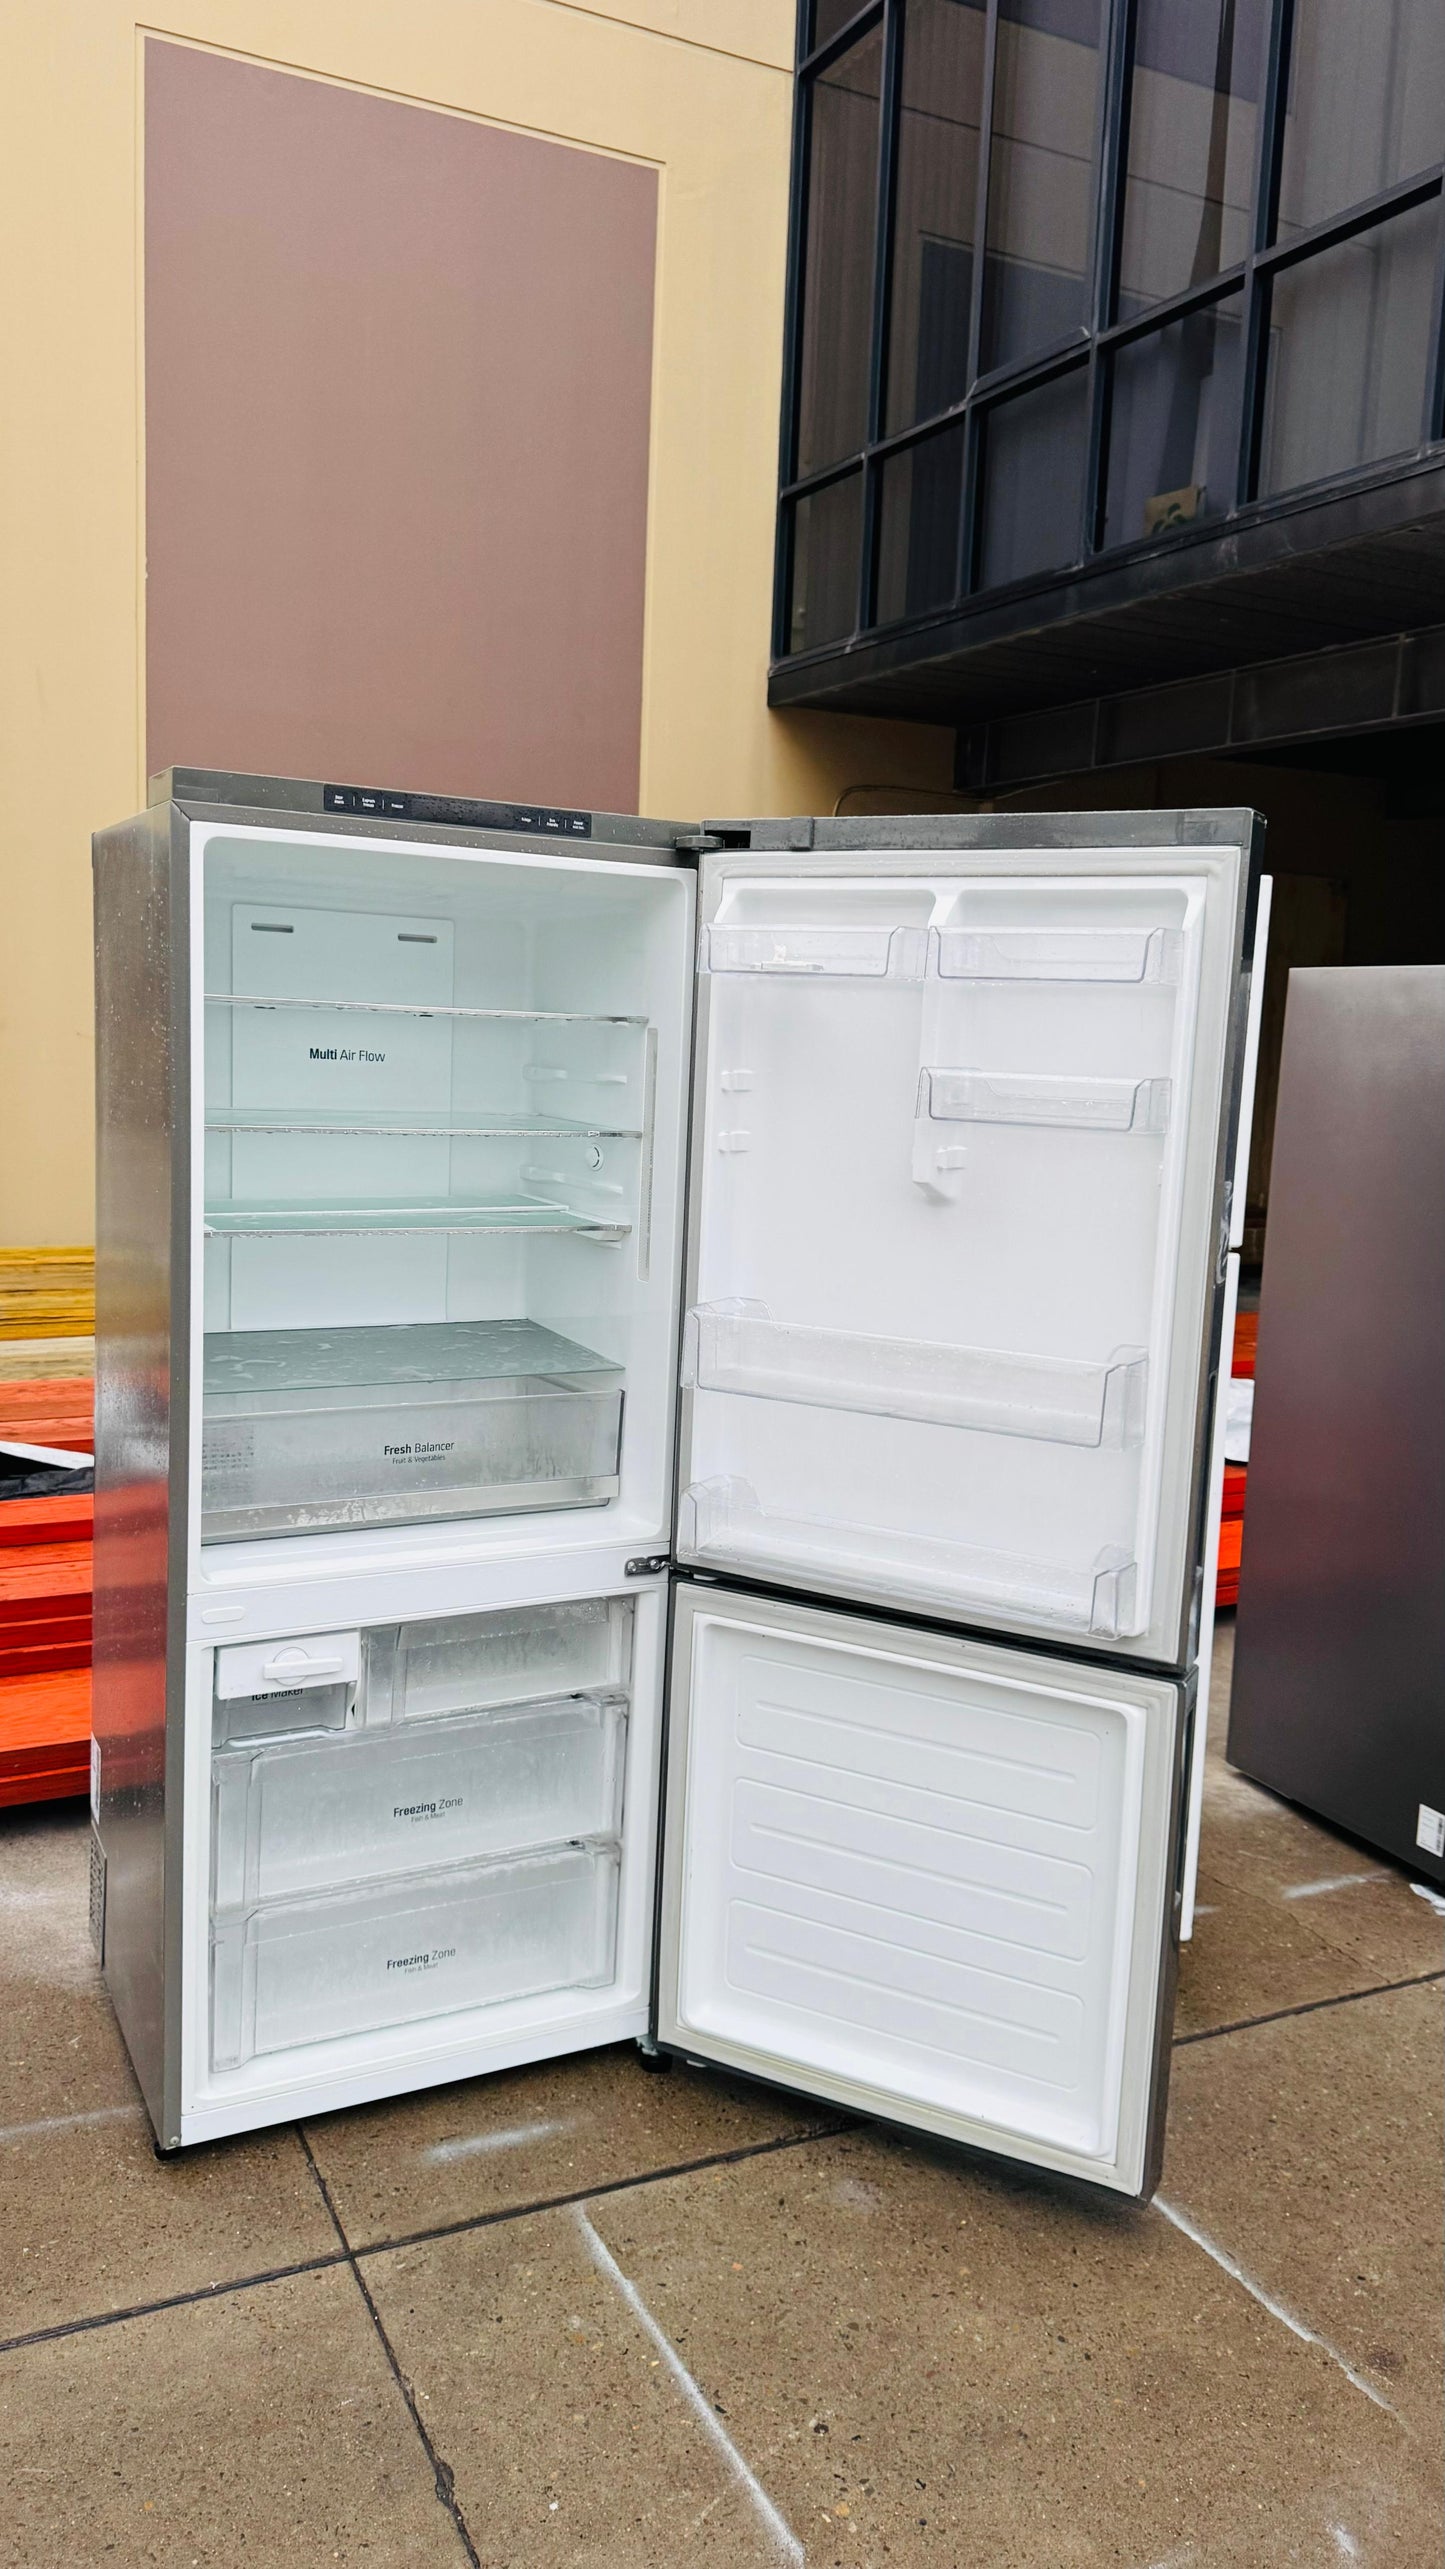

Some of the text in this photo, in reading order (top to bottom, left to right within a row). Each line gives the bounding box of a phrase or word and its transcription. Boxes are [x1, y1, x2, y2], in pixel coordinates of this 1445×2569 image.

[309, 1048, 385, 1062] Multi Air Flow
[384, 1442, 455, 1455] Fresh Balancer
[415, 1454, 446, 1463] Vegetables
[394, 1798, 463, 1817] Freezing Zone
[387, 1948, 456, 1970] Freezing Zone
